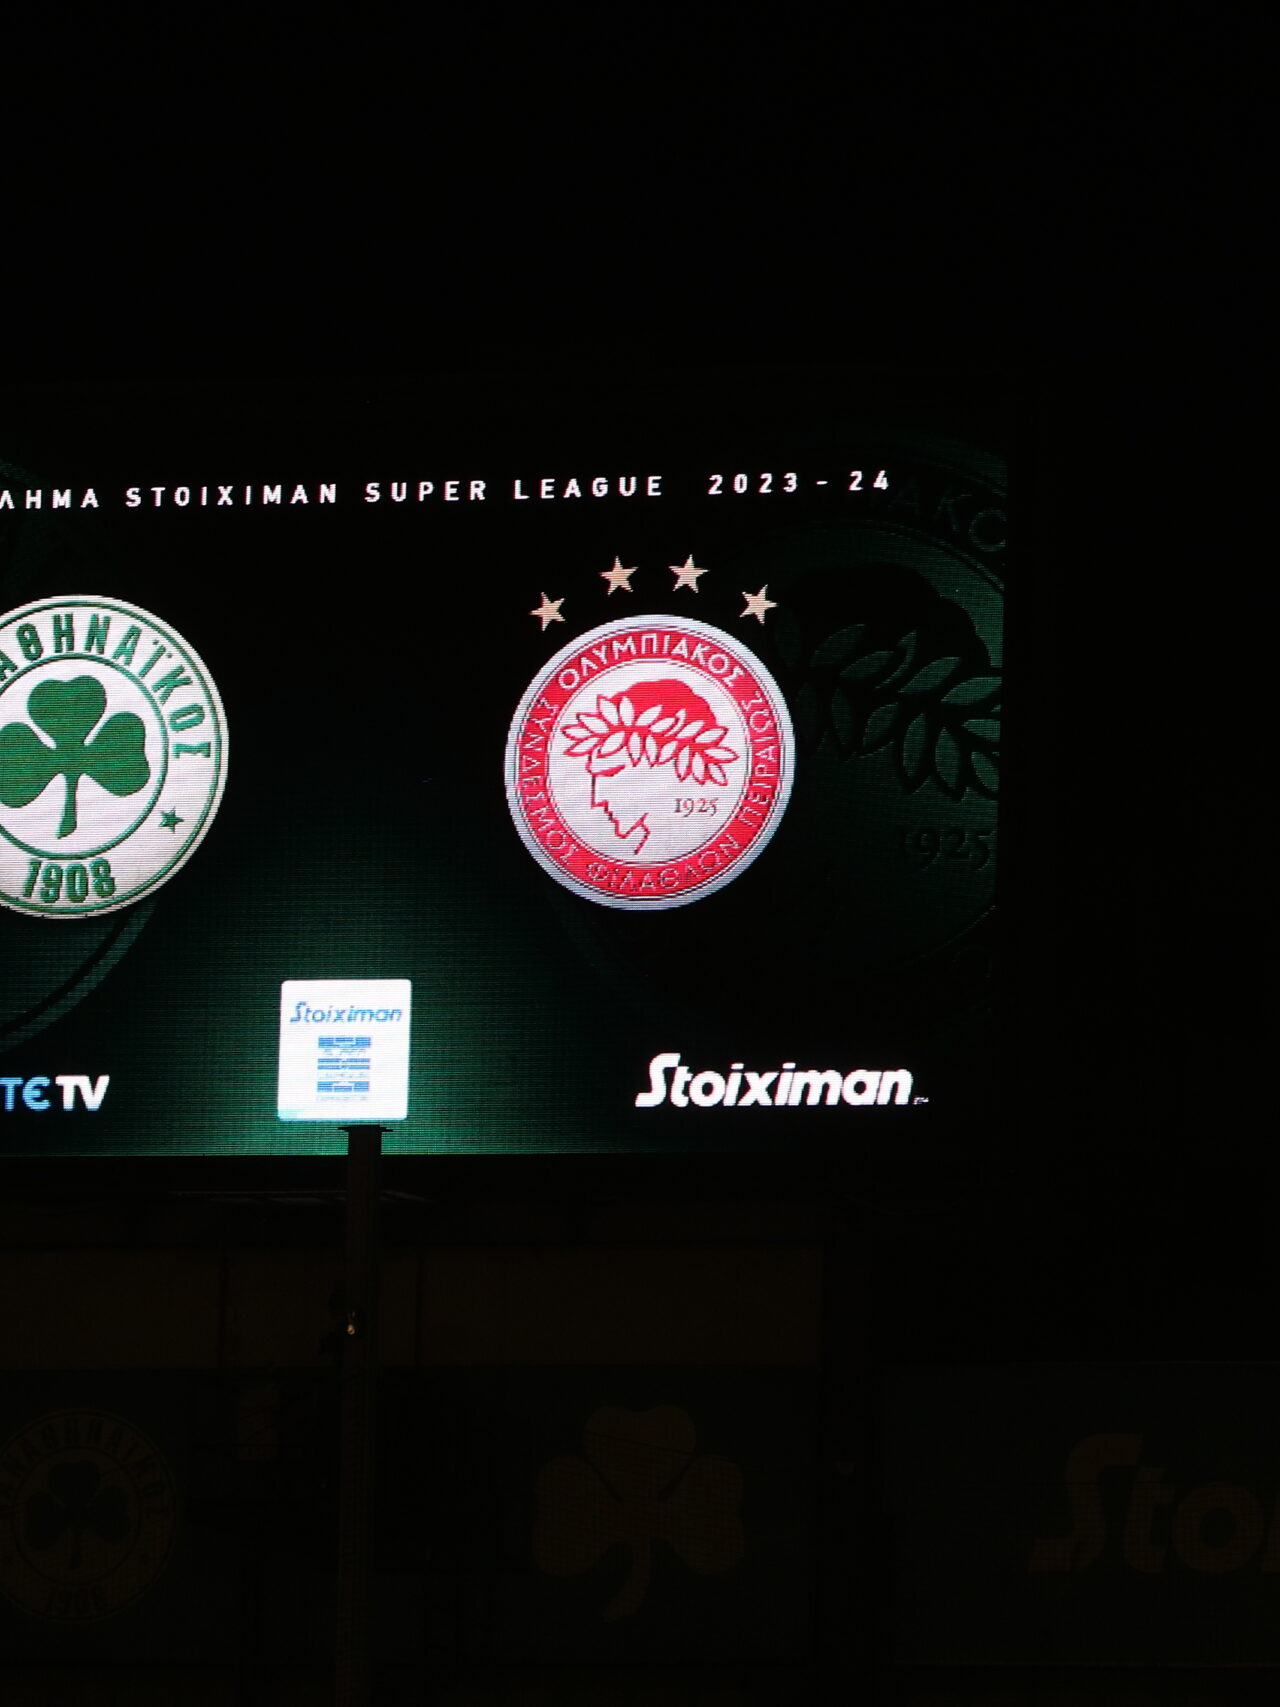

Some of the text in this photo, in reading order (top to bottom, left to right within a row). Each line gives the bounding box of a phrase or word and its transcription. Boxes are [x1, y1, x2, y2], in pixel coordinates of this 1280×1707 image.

[125, 483, 337, 508] STOIXIMAN
[364, 480, 486, 503] SUPER
[513, 475, 662, 500] LEAGUE
[708, 472, 798, 495] 2023
[848, 470, 889, 491] 24
[558, 633, 749, 690] ΟΛΥΜΠΙΑΚΟΣ
[673, 797, 719, 818] 1925
[23, 858, 116, 903] 1908
[289, 1000, 404, 1024] Stoiximan
[55, 1075, 110, 1111] TV
[634, 1052, 914, 1107] Stoiximan
